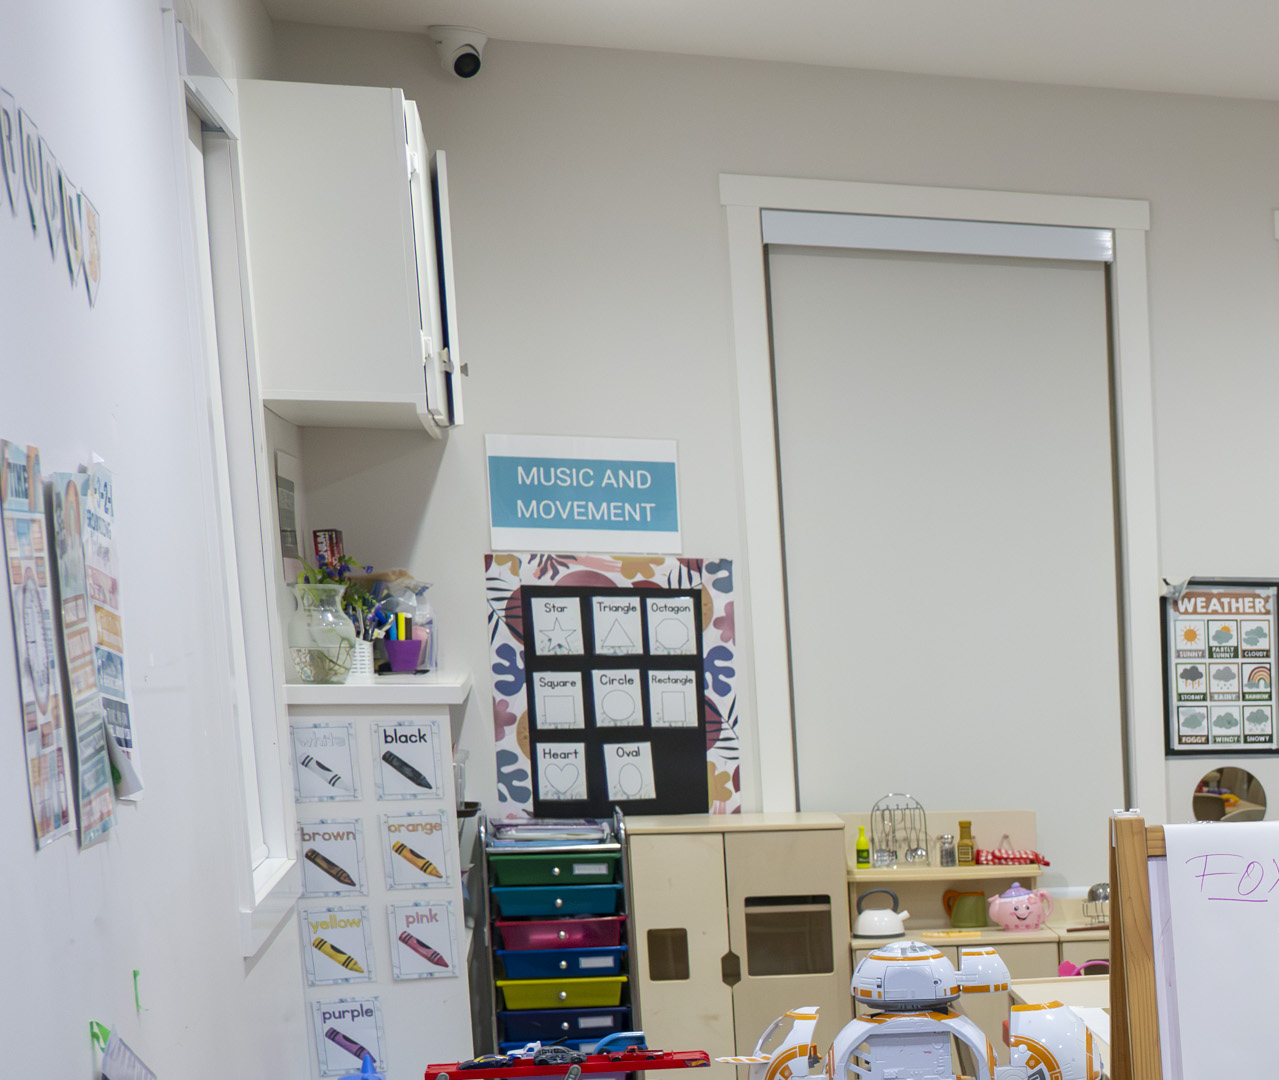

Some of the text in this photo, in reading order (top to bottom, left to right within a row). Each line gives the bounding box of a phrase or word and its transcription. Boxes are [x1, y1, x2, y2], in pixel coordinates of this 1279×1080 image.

[517, 466, 651, 489] MUSIC AND
[517, 499, 655, 521] MOVEMENT
[544, 603, 568, 613] Star
[596, 602, 637, 614] Triangle
[651, 603, 691, 614] Octagon
[1177, 597, 1266, 613] WEATHER
[539, 677, 576, 689] Square
[600, 675, 634, 686] Circle
[652, 675, 694, 686] Rectangle
[383, 728, 428, 744] black
[543, 748, 579, 759] Heart
[616, 746, 640, 758] Oval
[301, 827, 356, 842] brown
[388, 822, 442, 835] orange
[405, 908, 438, 927] pink
[309, 915, 361, 934] yellow
[322, 1003, 374, 1023] purple
